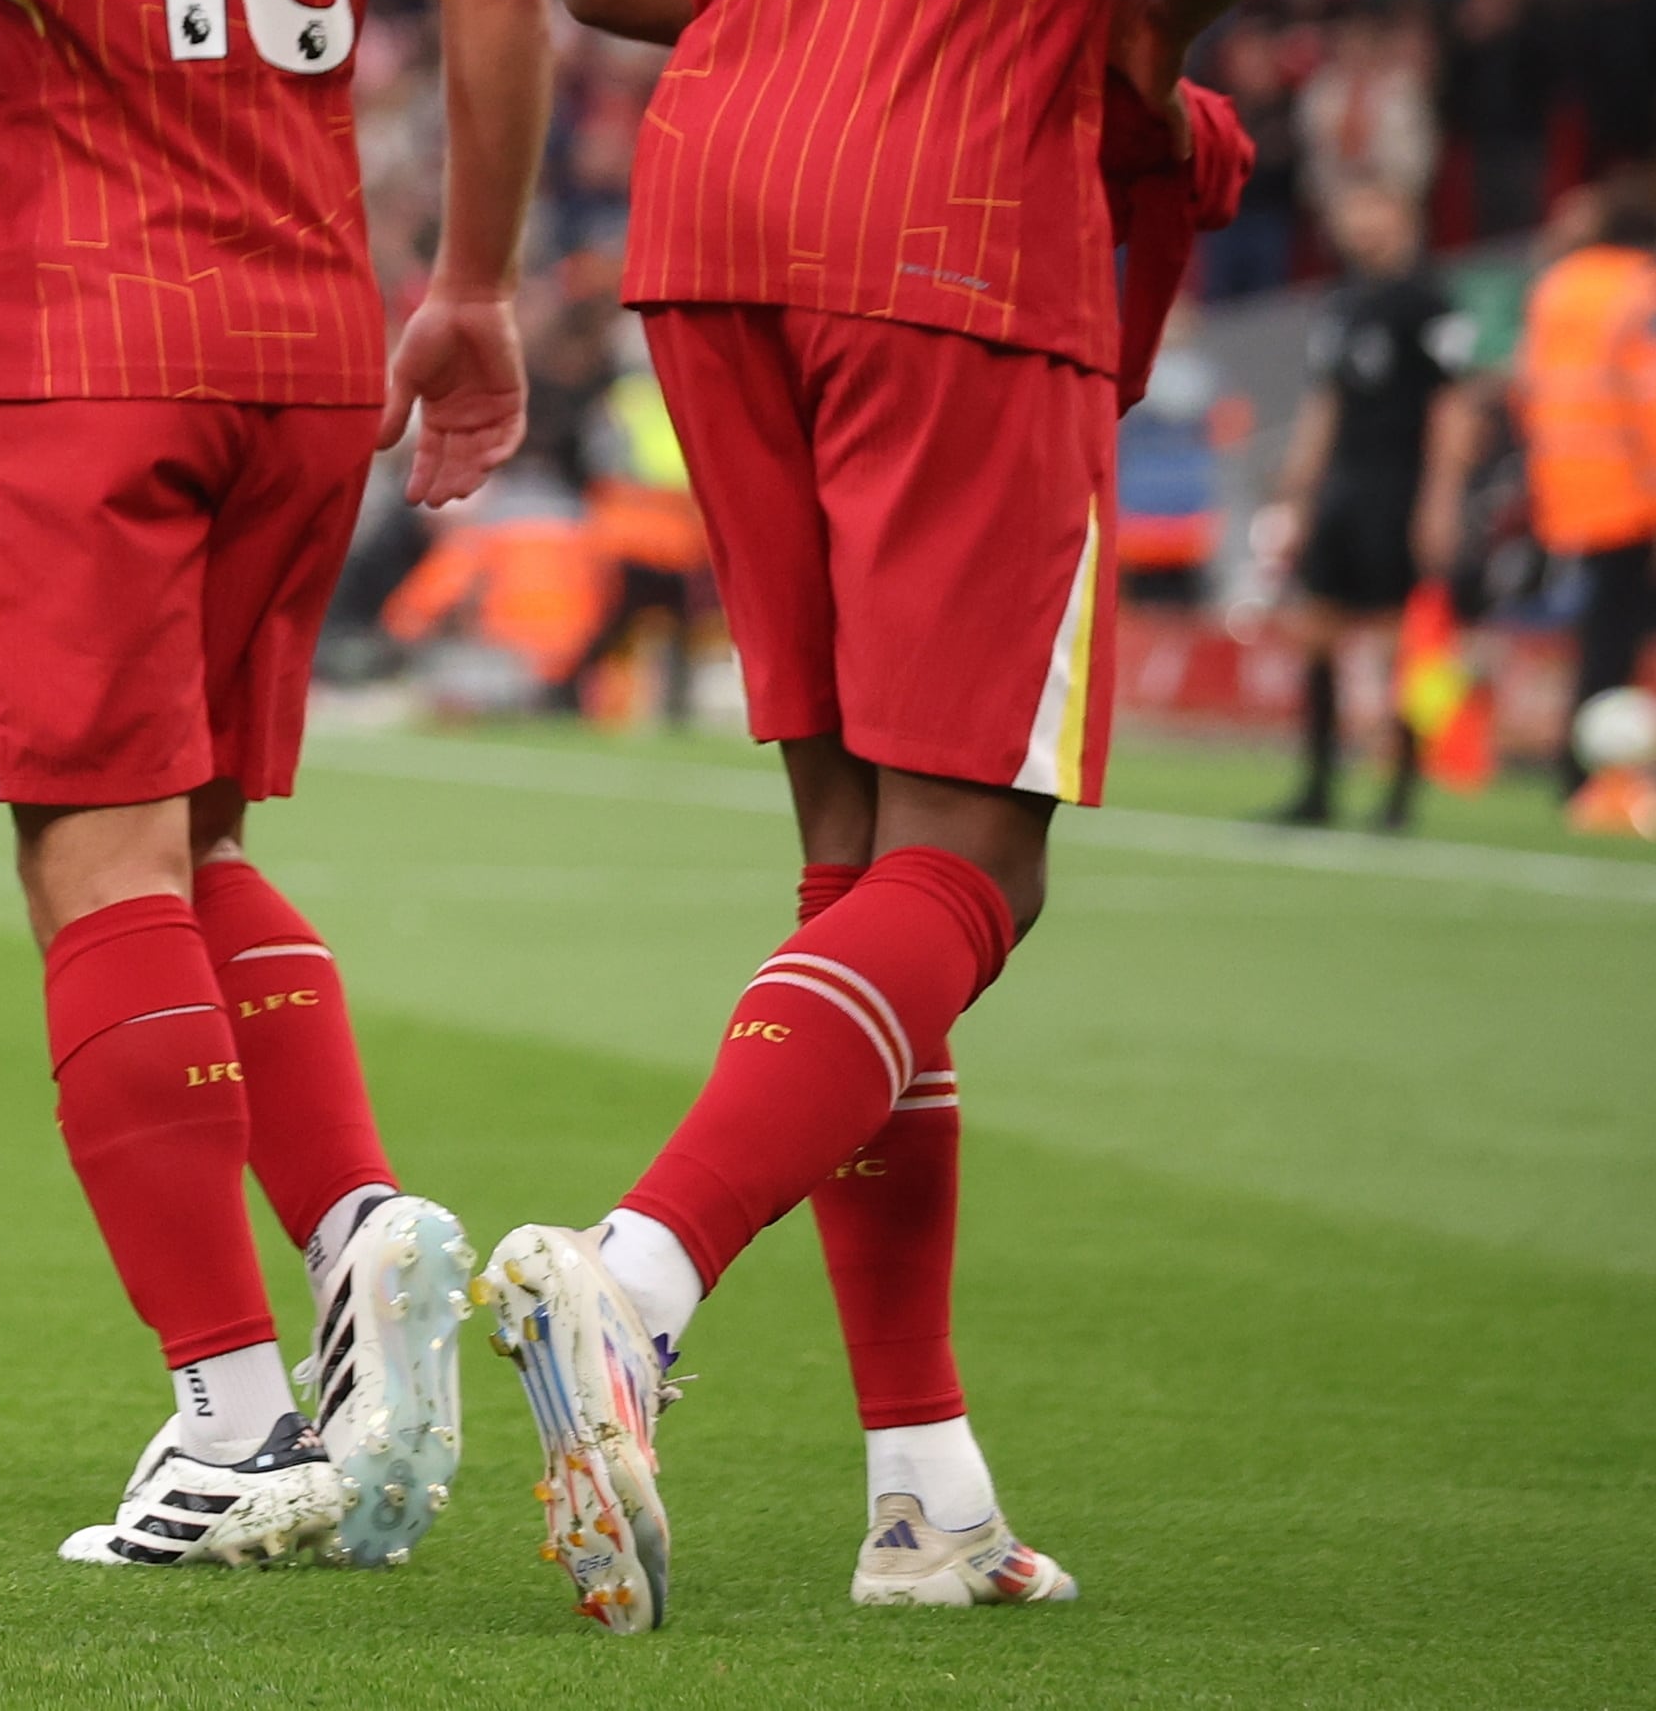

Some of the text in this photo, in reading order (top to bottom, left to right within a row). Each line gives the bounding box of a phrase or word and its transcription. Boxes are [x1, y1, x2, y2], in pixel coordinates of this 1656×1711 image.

[239, 990, 320, 1019] LFC
[727, 1020, 793, 1045] LFC
[184, 1061, 245, 1088] LFC
